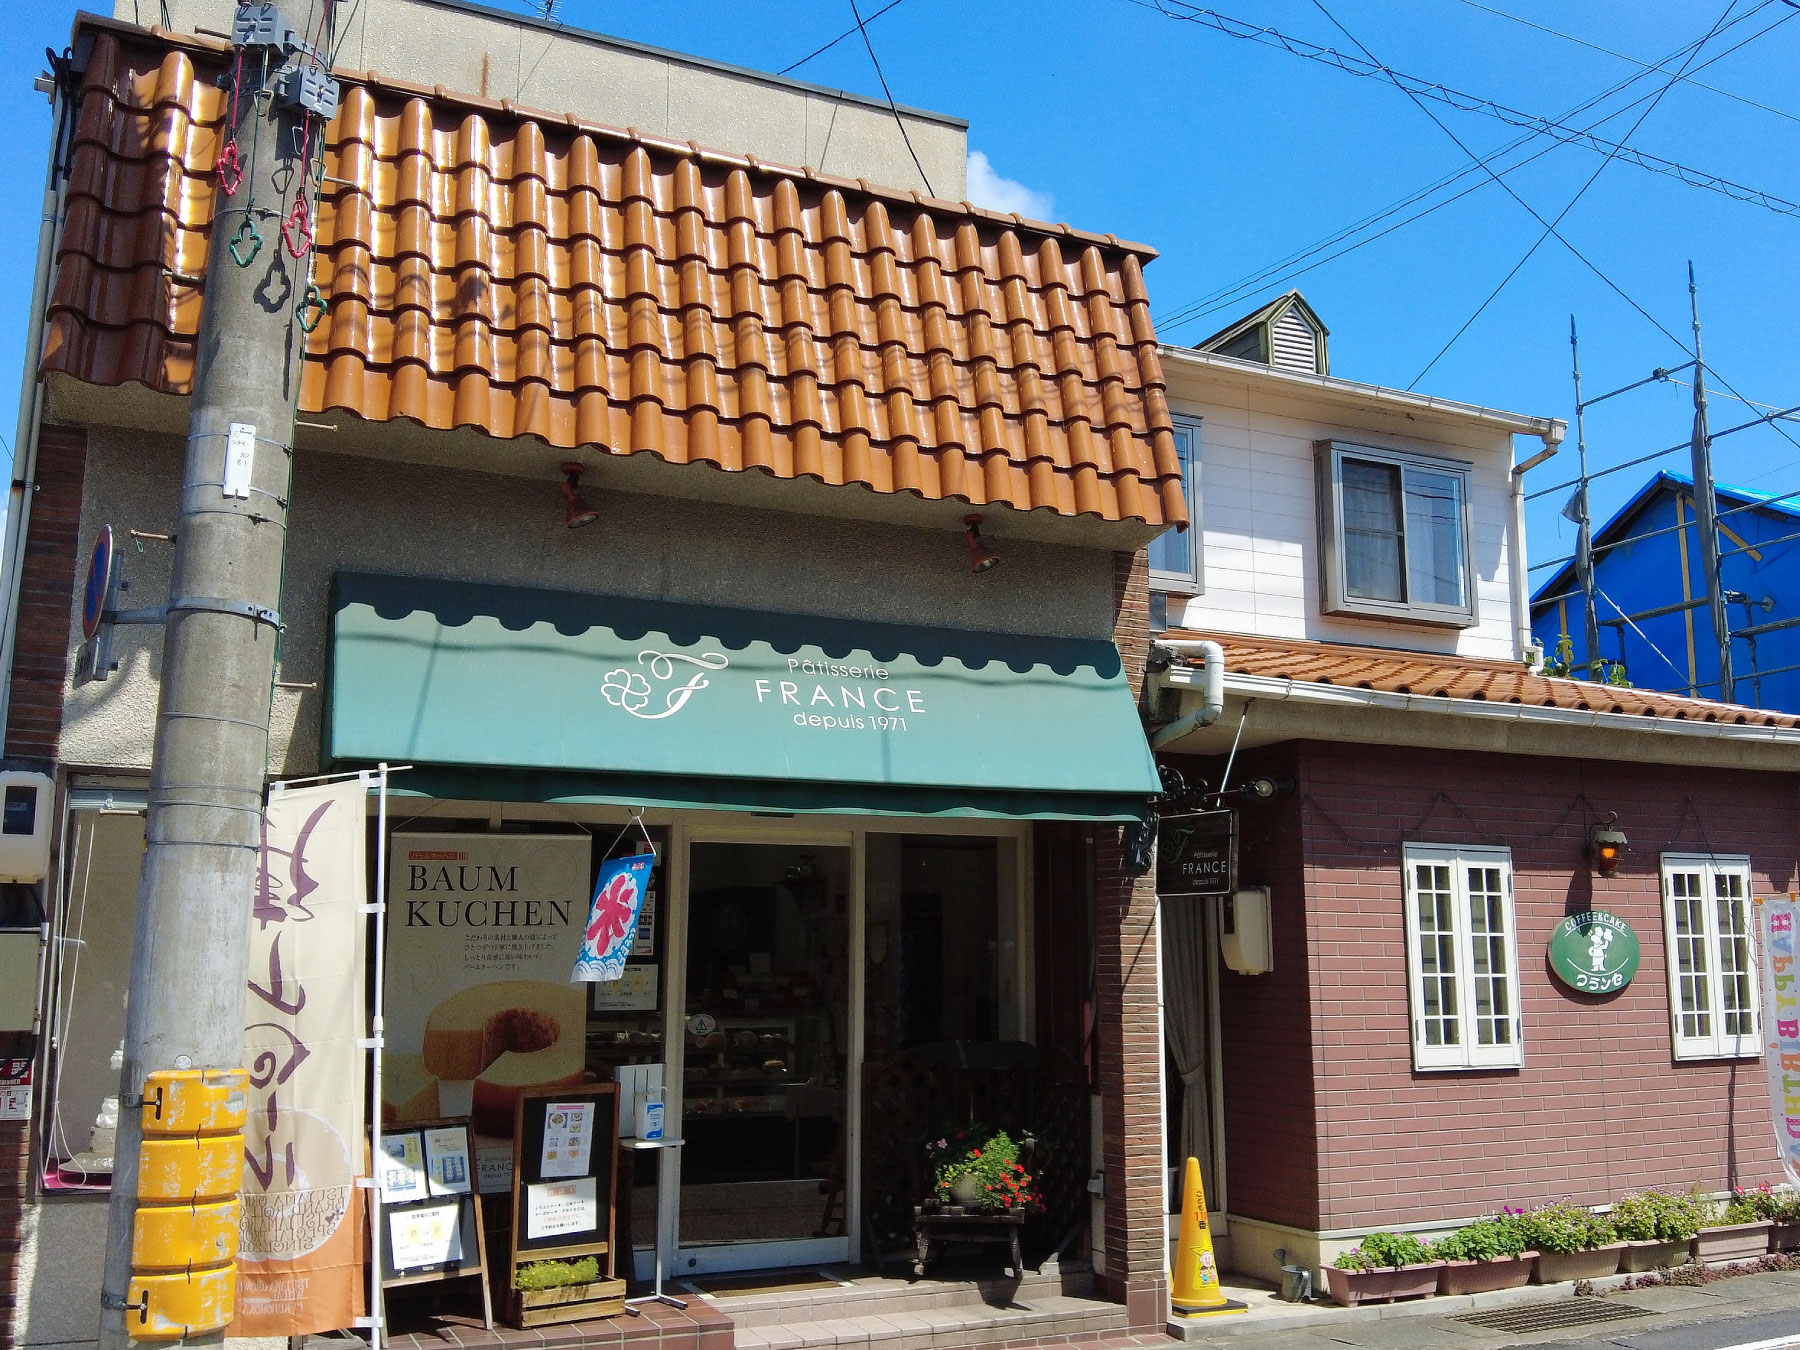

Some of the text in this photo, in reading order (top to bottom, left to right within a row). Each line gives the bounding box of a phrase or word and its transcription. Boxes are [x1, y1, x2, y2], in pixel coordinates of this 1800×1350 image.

[787, 656, 890, 682] Pâtisserie
[755, 678, 927, 714] FRANCE
[793, 709, 908, 733] depuis 1971
[407, 864, 519, 892] BAUM
[1182, 860, 1227, 875] FRANCE
[405, 899, 572, 927] KUCHEN
[586, 873, 635, 957] 氷
[1564, 911, 1627, 932] COFFEE&CAKE
[1771, 912, 1797, 1013] HAPPY
[1576, 973, 1623, 991] フランセ
